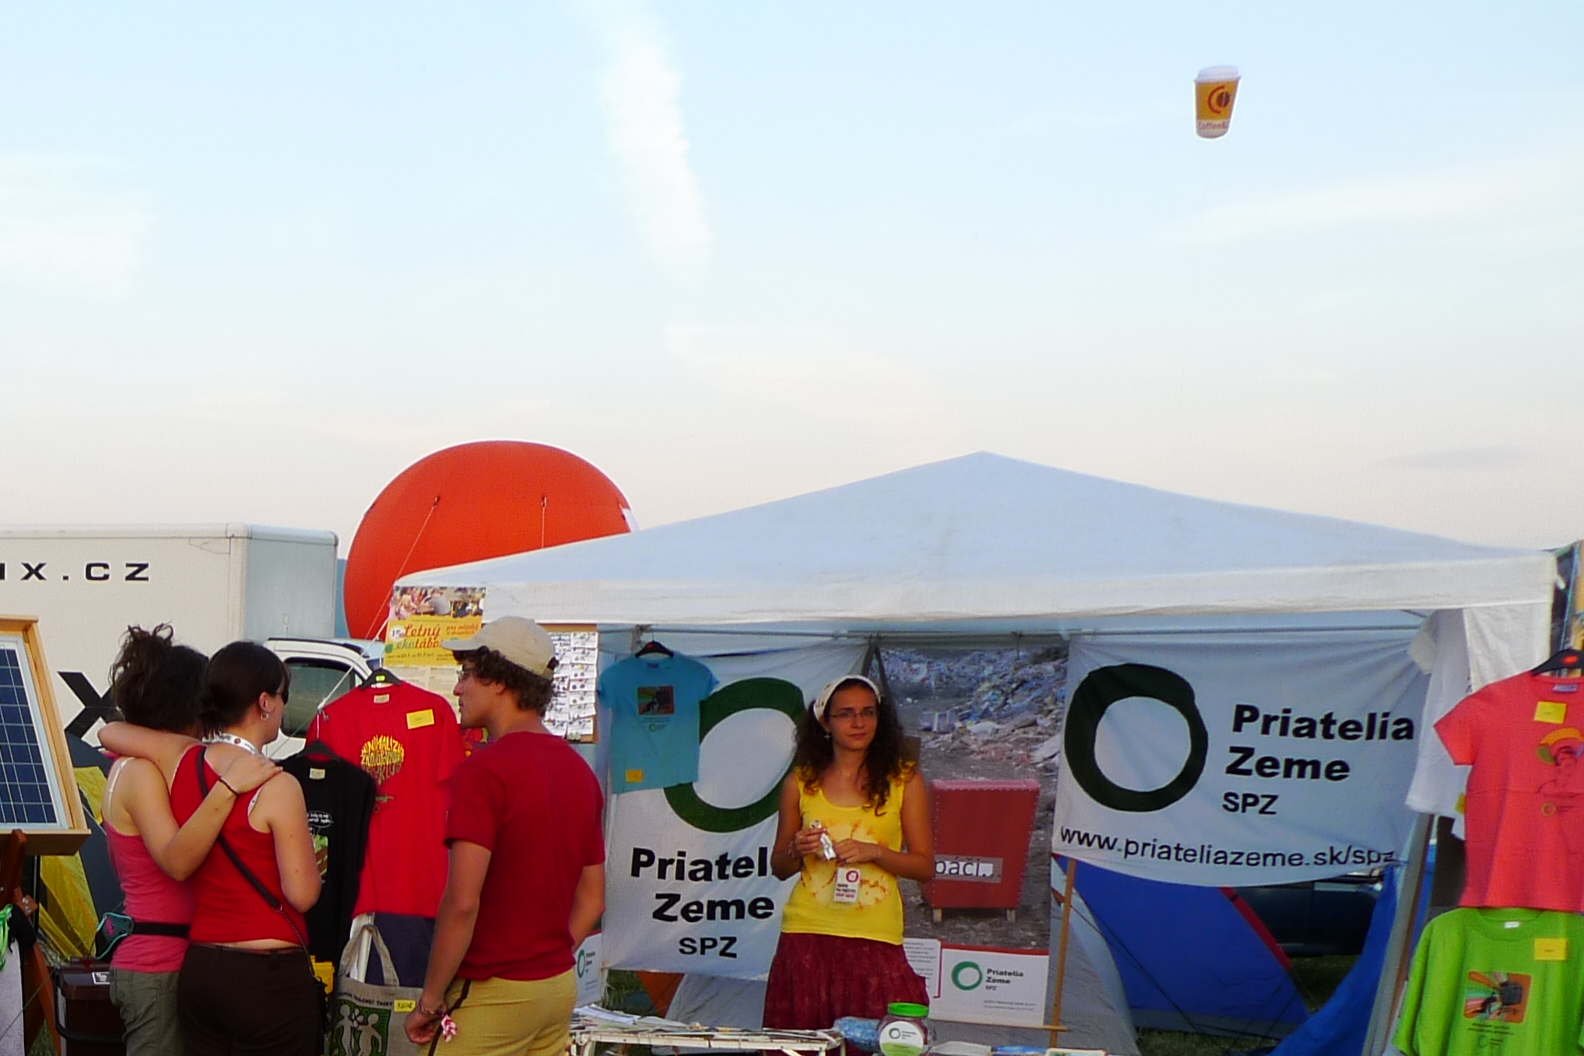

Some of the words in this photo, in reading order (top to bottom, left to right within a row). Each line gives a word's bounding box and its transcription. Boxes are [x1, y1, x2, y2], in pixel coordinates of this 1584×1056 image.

[396, 637, 444, 650] ekotábo
[1233, 703, 1416, 742] Priatelia
[1225, 746, 1351, 782] Zeme
[1222, 792, 1279, 816] SPZ
[1060, 825, 1397, 868] www.priateliazeme.sk/spz
[630, 846, 774, 882] Priatel
[652, 892, 775, 922] Zeme
[678, 936, 738, 959] SPZ
[986, 968, 1024, 978] Priatelia
